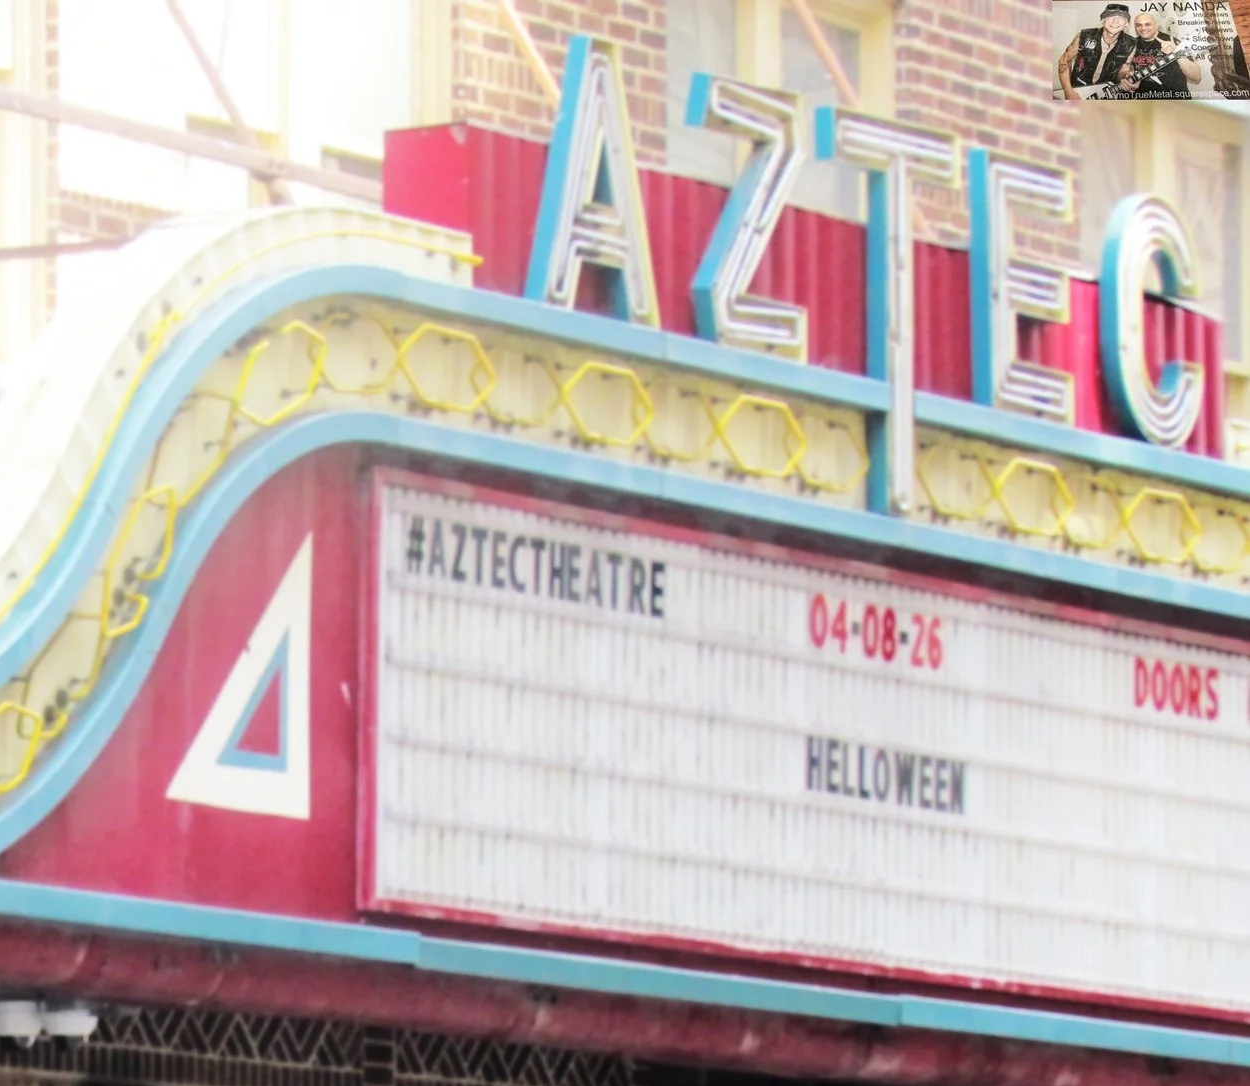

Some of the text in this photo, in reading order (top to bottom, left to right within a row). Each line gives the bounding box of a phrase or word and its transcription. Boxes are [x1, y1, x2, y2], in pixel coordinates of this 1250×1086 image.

[524, 34, 1206, 514] AZTEC
[405, 514, 665, 618] #AZTECTHEATRE
[808, 592, 944, 670] 04-08-26
[1133, 655, 1220, 722] DOORS
[805, 735, 966, 815] HELLOWEEN
